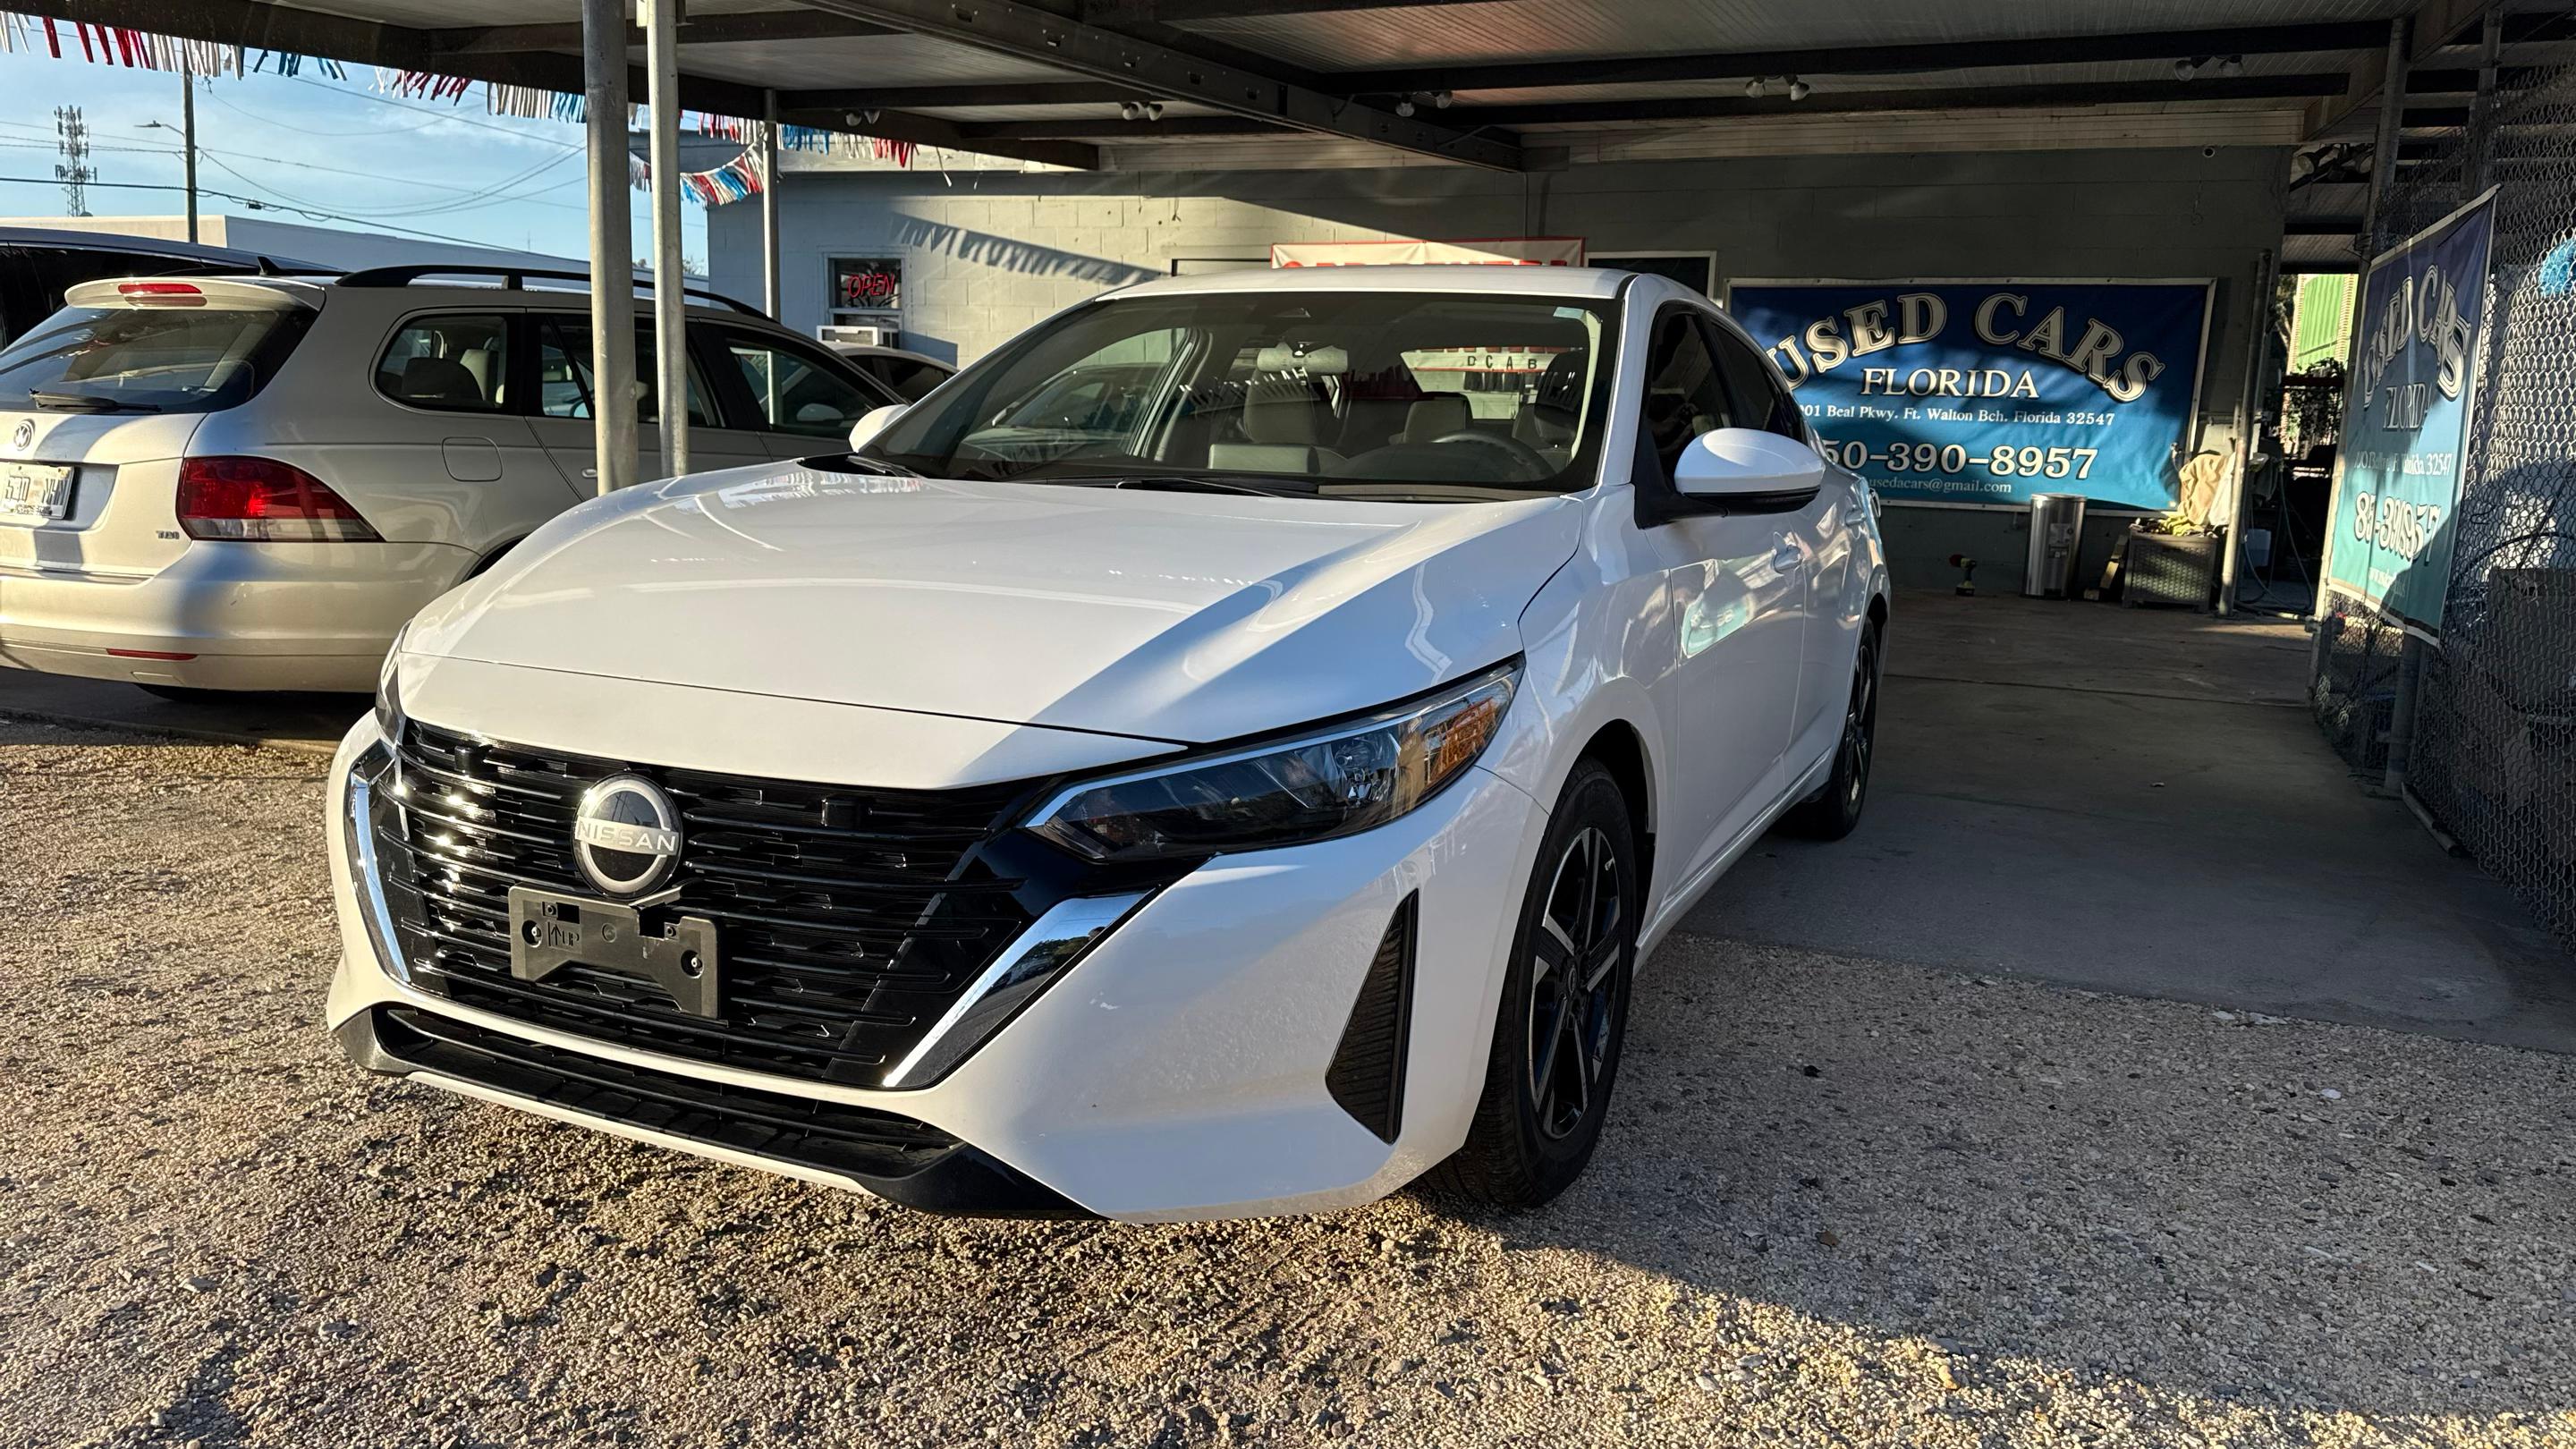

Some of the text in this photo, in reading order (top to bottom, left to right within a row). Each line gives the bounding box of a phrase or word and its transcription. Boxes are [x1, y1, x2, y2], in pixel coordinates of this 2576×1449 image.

[847, 272, 895, 298] OPEN
[1767, 292, 2165, 402] USED CARS
[1860, 368, 2039, 398] FLORIDA
[1827, 405, 1854, 418] Beal
[1860, 406, 1898, 421] Pkwy.
[1903, 408, 1921, 419] Ft.
[1928, 408, 1973, 421] Walton
[1978, 410, 2008, 422] Bch.
[2014, 411, 2061, 424] Florida
[2066, 412, 2115, 426] 32547
[1822, 439, 2098, 479] 50-390-8957
[576, 820, 676, 852] NISSAN
